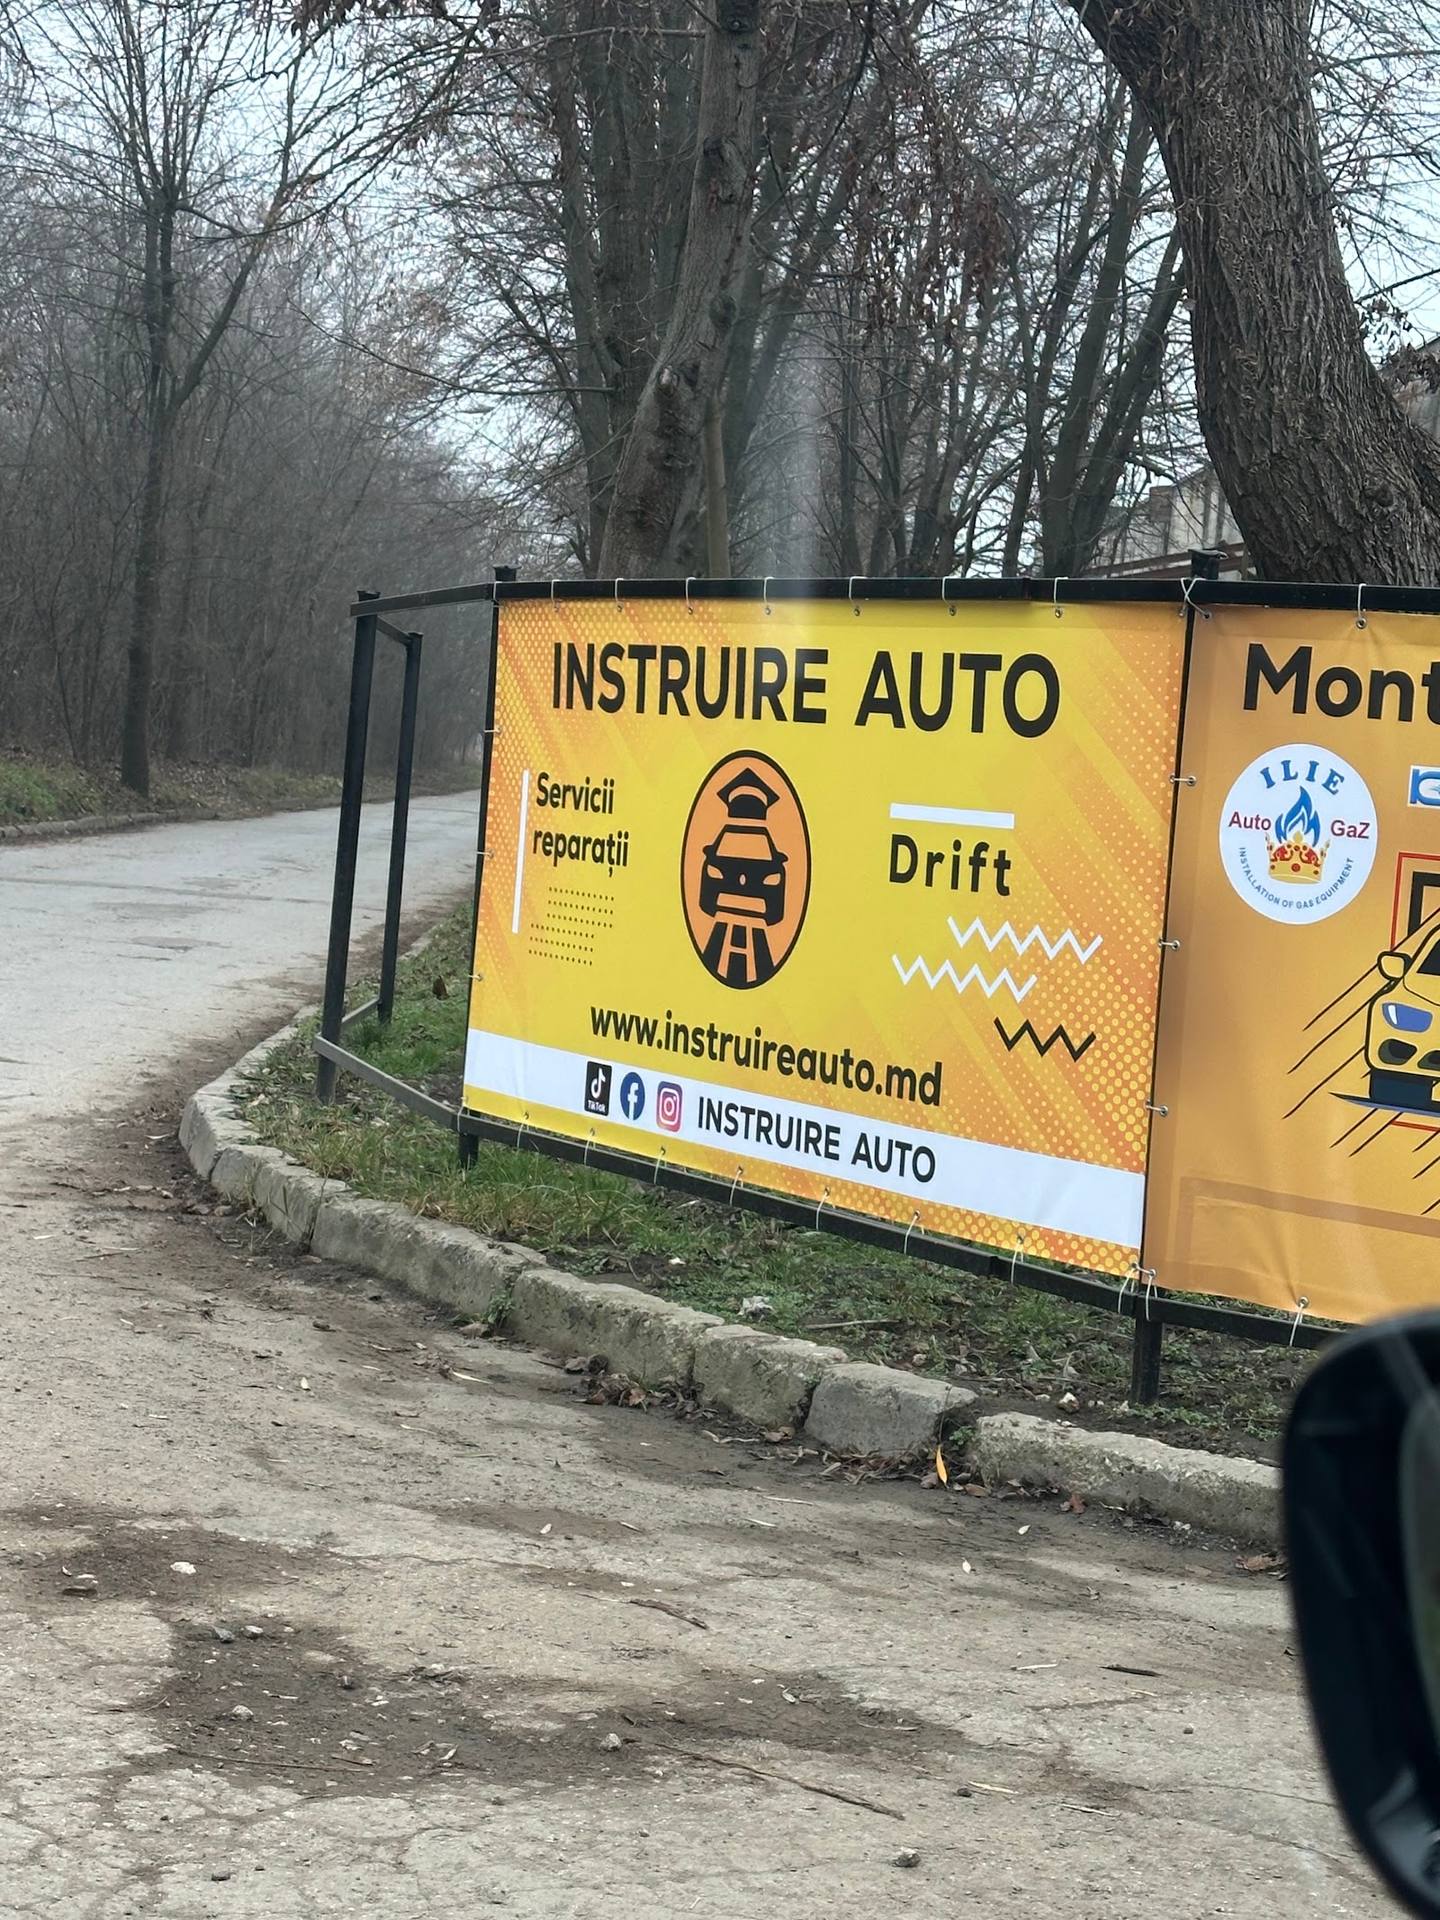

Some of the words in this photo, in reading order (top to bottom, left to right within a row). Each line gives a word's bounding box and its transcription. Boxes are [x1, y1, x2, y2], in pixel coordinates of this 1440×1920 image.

[552, 641, 829, 724] INSTRUIRE
[854, 650, 1061, 738] AUTO
[536, 772, 615, 814] Servicii
[1260, 760, 1345, 795] ILIE
[1228, 811, 1272, 831] Auto
[533, 829, 629, 877] reparații
[889, 834, 1012, 896] Drift
[1239, 847, 1281, 905] INSTALLATION
[1281, 899, 1294, 909] OF
[1296, 899, 1314, 910] GAS
[1315, 857, 1354, 905] EQUIPMENT
[590, 1005, 943, 1107] www.instruireauto.md
[587, 1099, 606, 1113] TikTok
[698, 1096, 841, 1161] INSTRUIRE
[851, 1132, 937, 1183] AUTO
